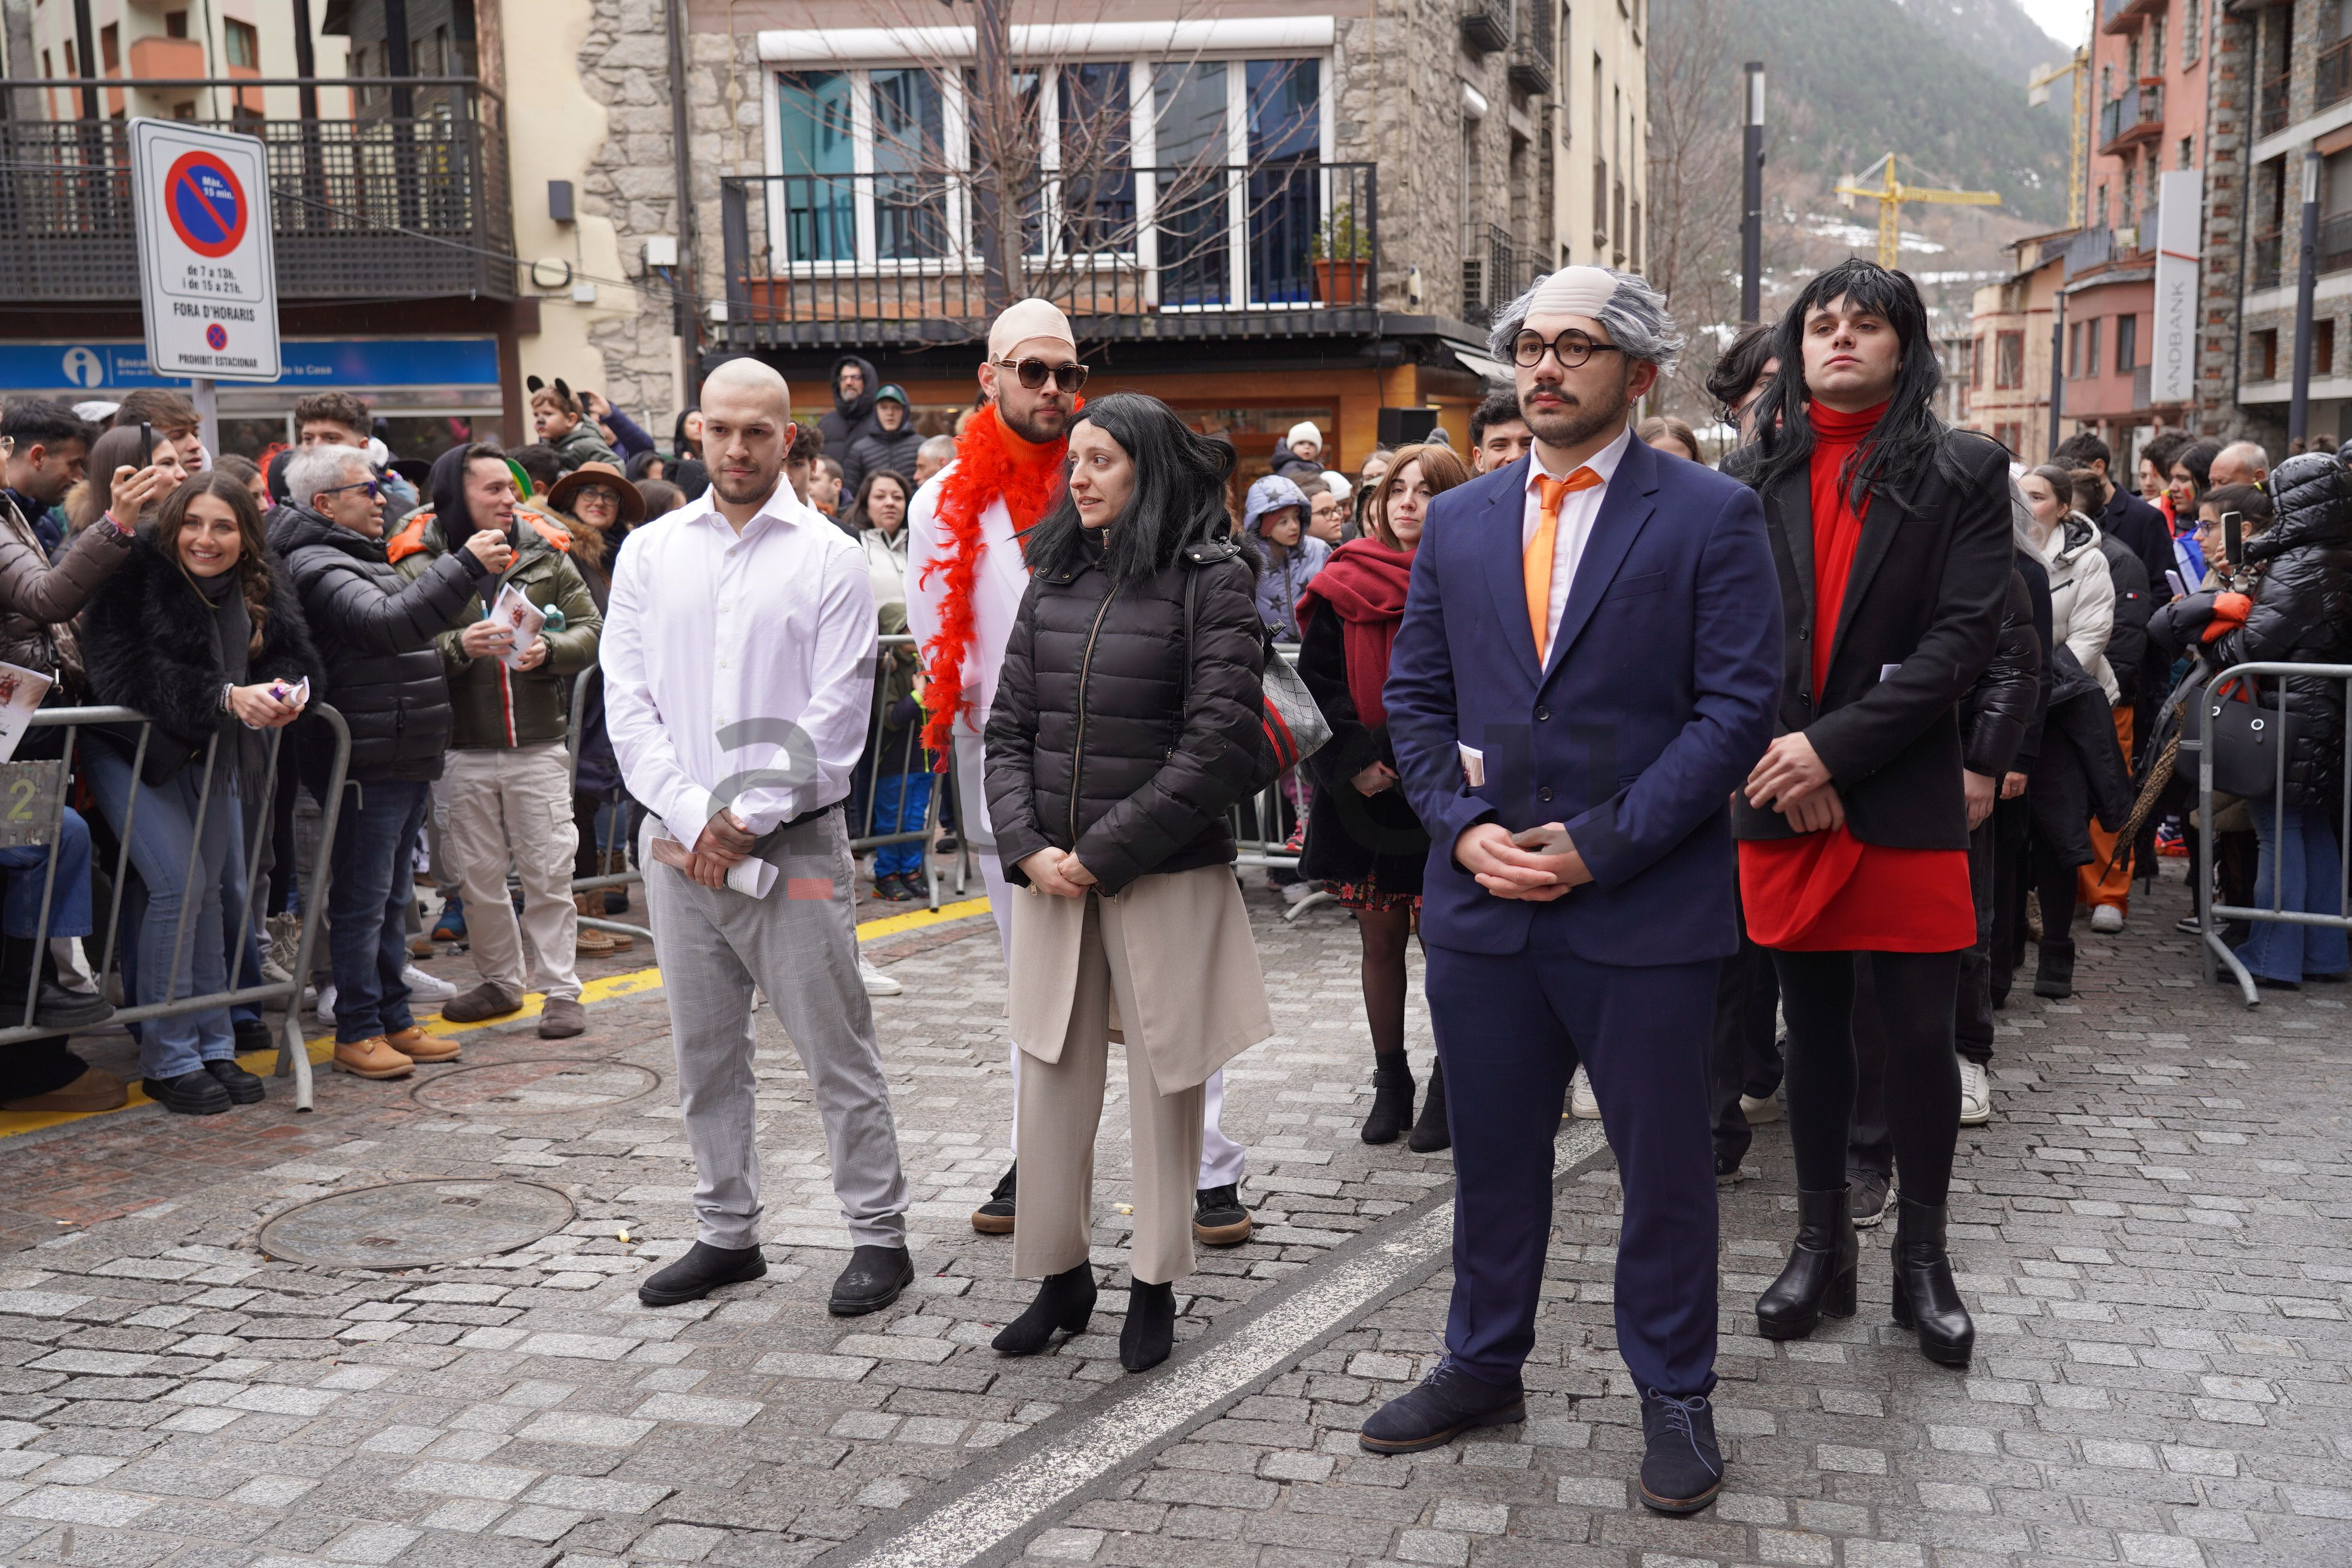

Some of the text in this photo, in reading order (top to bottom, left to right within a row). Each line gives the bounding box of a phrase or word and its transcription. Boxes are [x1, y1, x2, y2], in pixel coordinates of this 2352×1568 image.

[204, 186, 234, 200] 15 min.
[188, 264, 198, 275] de
[201, 266, 206, 276] 7
[218, 268, 237, 280] 13h.
[182, 277, 186, 289] i
[189, 279, 199, 289] de
[203, 280, 213, 292] 15
[224, 282, 243, 294] 21h.
[173, 302, 255, 322] FORA D'HORARIS
[2167, 280, 2185, 397] ANDBANK
[179, 354, 258, 369] PROHIBIT ESTACIONAR
[7, 778, 36, 820] 2
